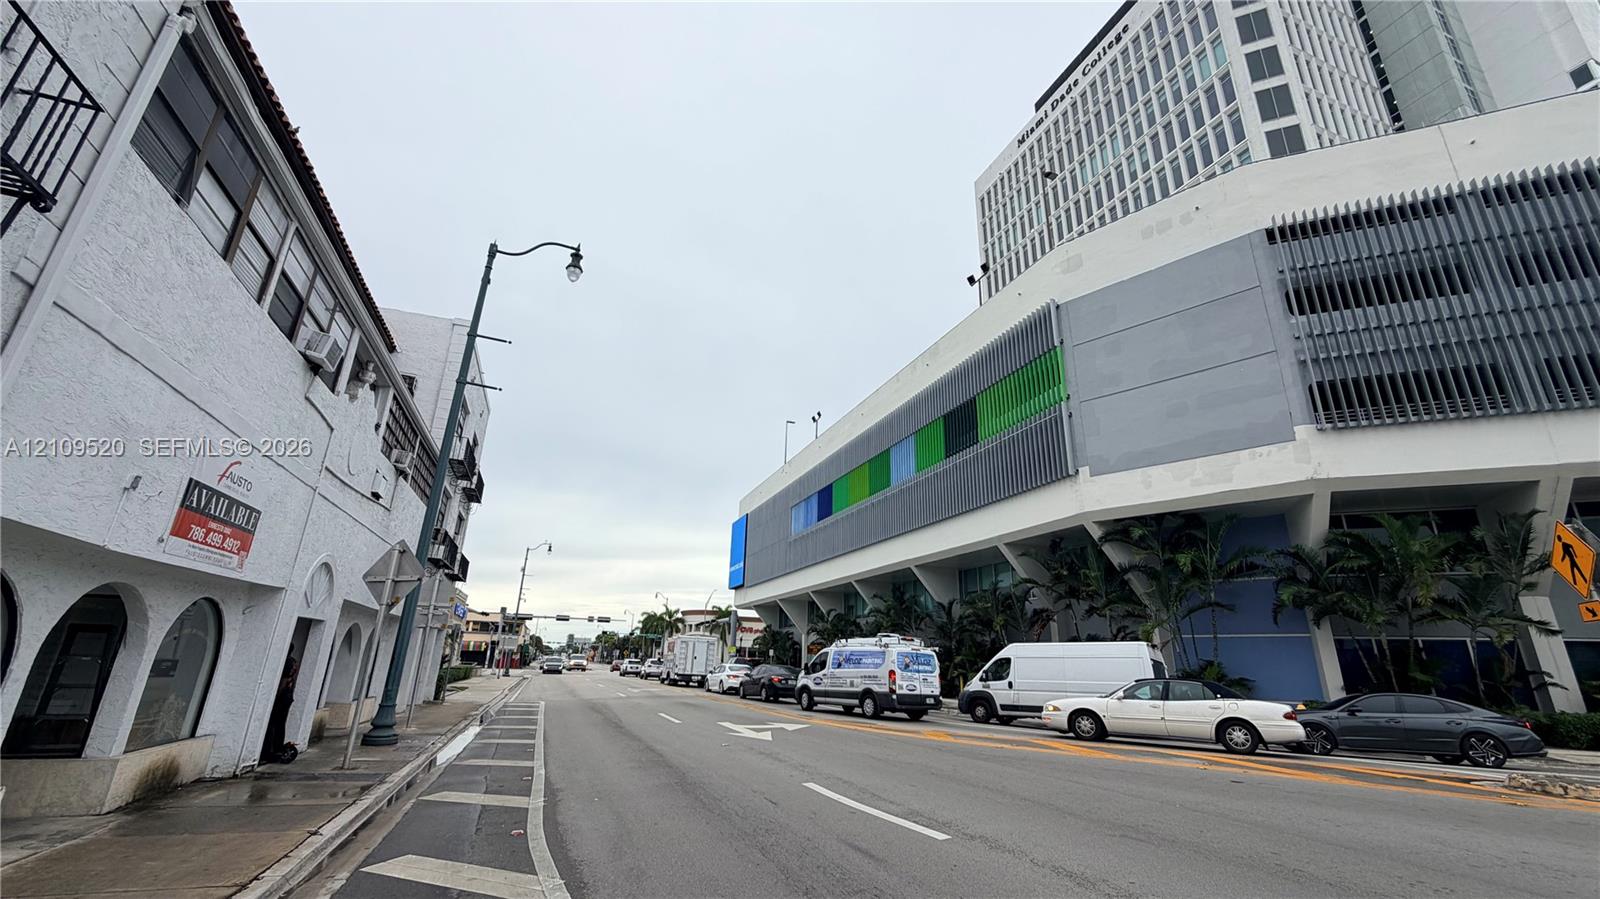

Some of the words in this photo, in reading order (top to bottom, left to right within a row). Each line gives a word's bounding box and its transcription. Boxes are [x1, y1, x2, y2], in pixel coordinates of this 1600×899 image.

[1017, 110, 1049, 148] Miami
[1050, 78, 1079, 112] Dade
[1082, 24, 1129, 77] College
[186, 486, 260, 532] AVAILABLE
[187, 524, 241, 554] 786.499.4912
